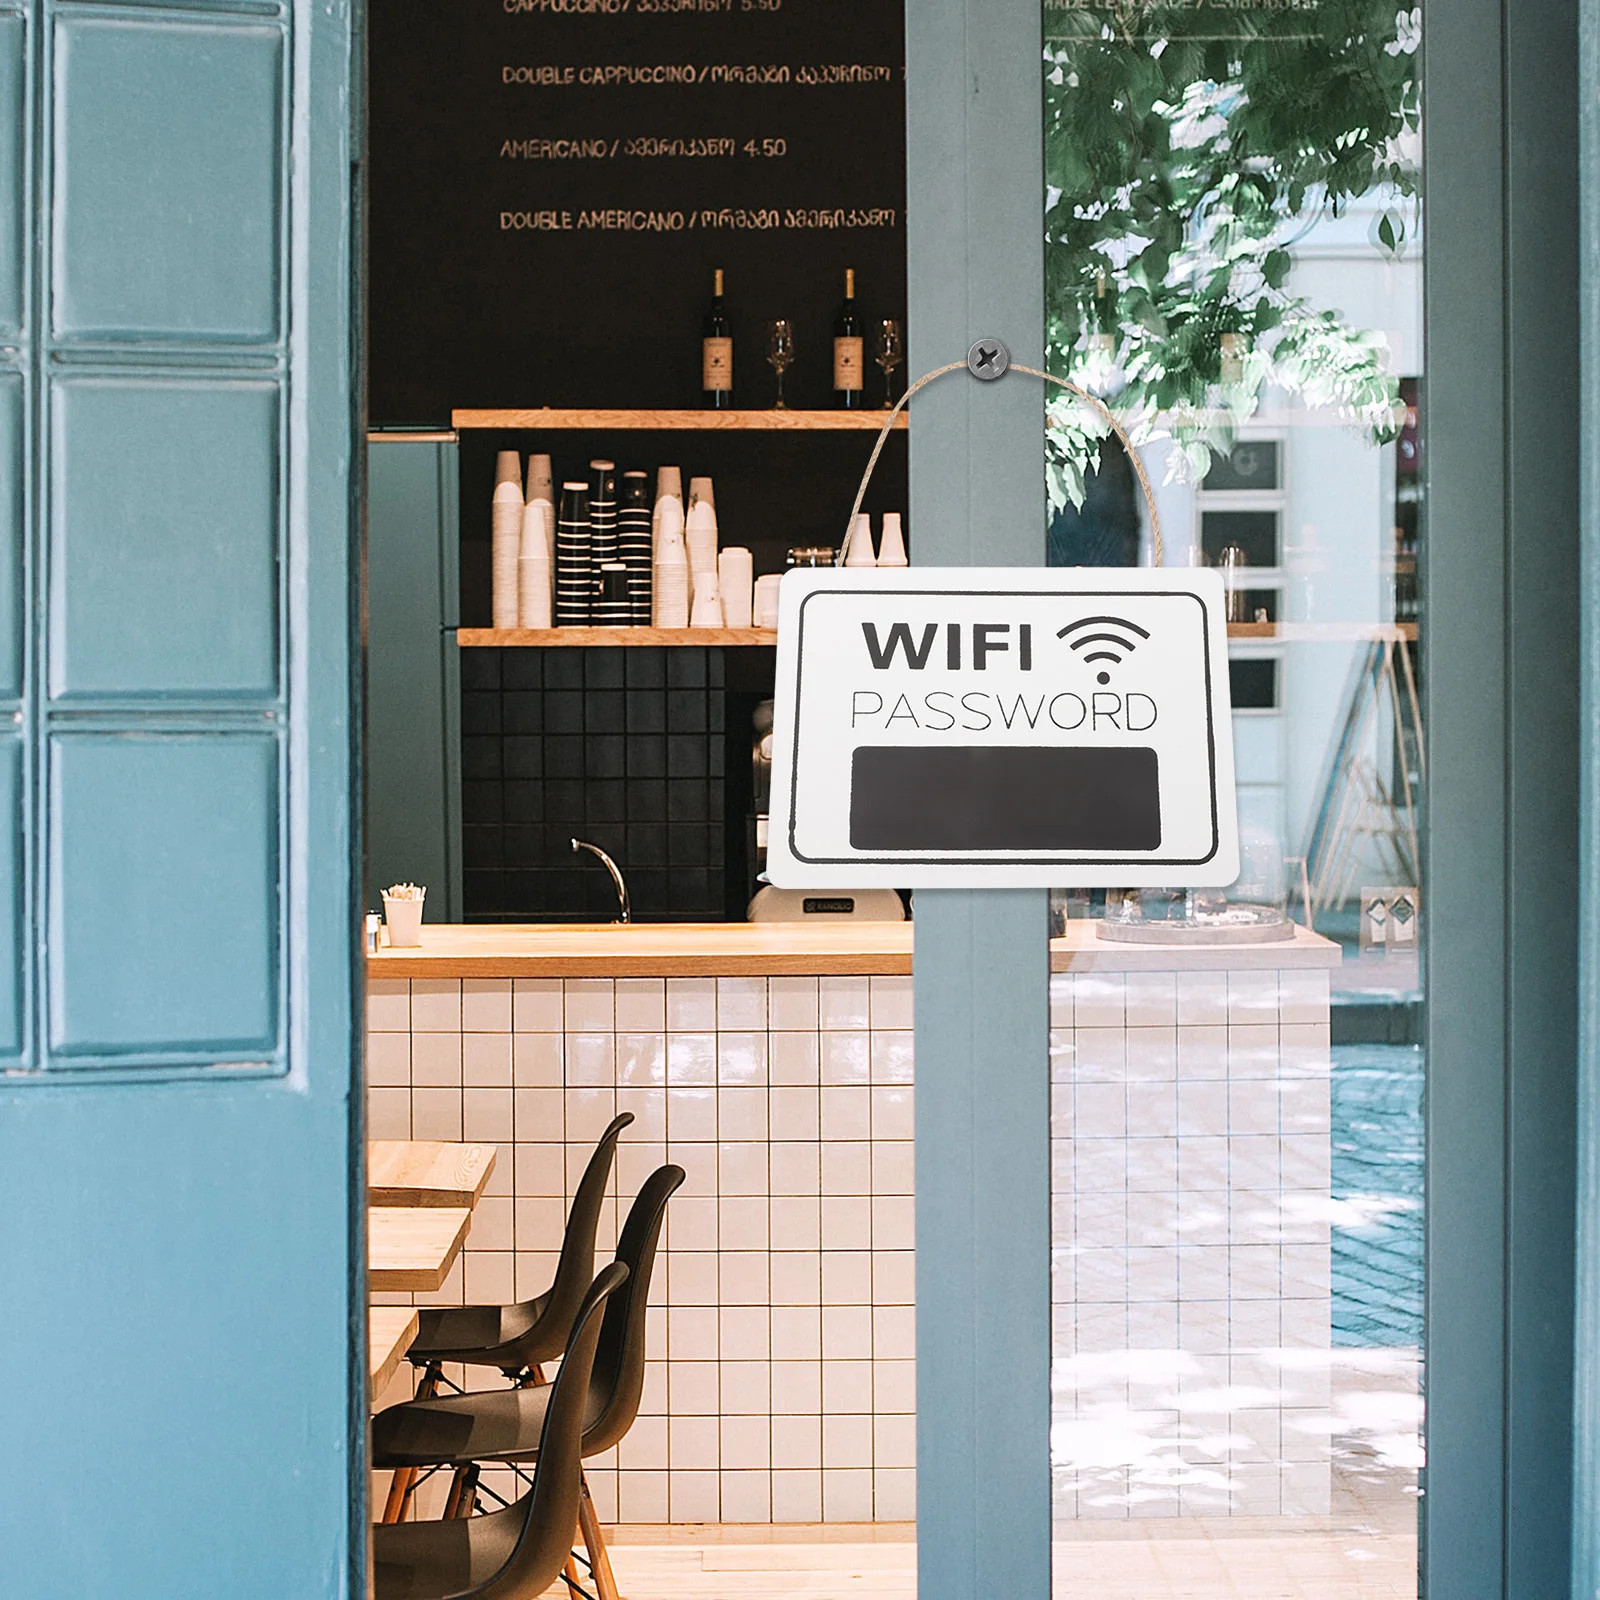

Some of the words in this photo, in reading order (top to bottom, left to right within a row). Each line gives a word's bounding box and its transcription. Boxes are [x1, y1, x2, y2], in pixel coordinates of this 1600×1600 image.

[502, 66, 576, 86] DOUBLE
[743, 138, 787, 158] 4.50
[500, 211, 573, 231] DOUBLE
[861, 622, 1032, 671] WIFI
[851, 691, 1158, 732] PASSWORD
